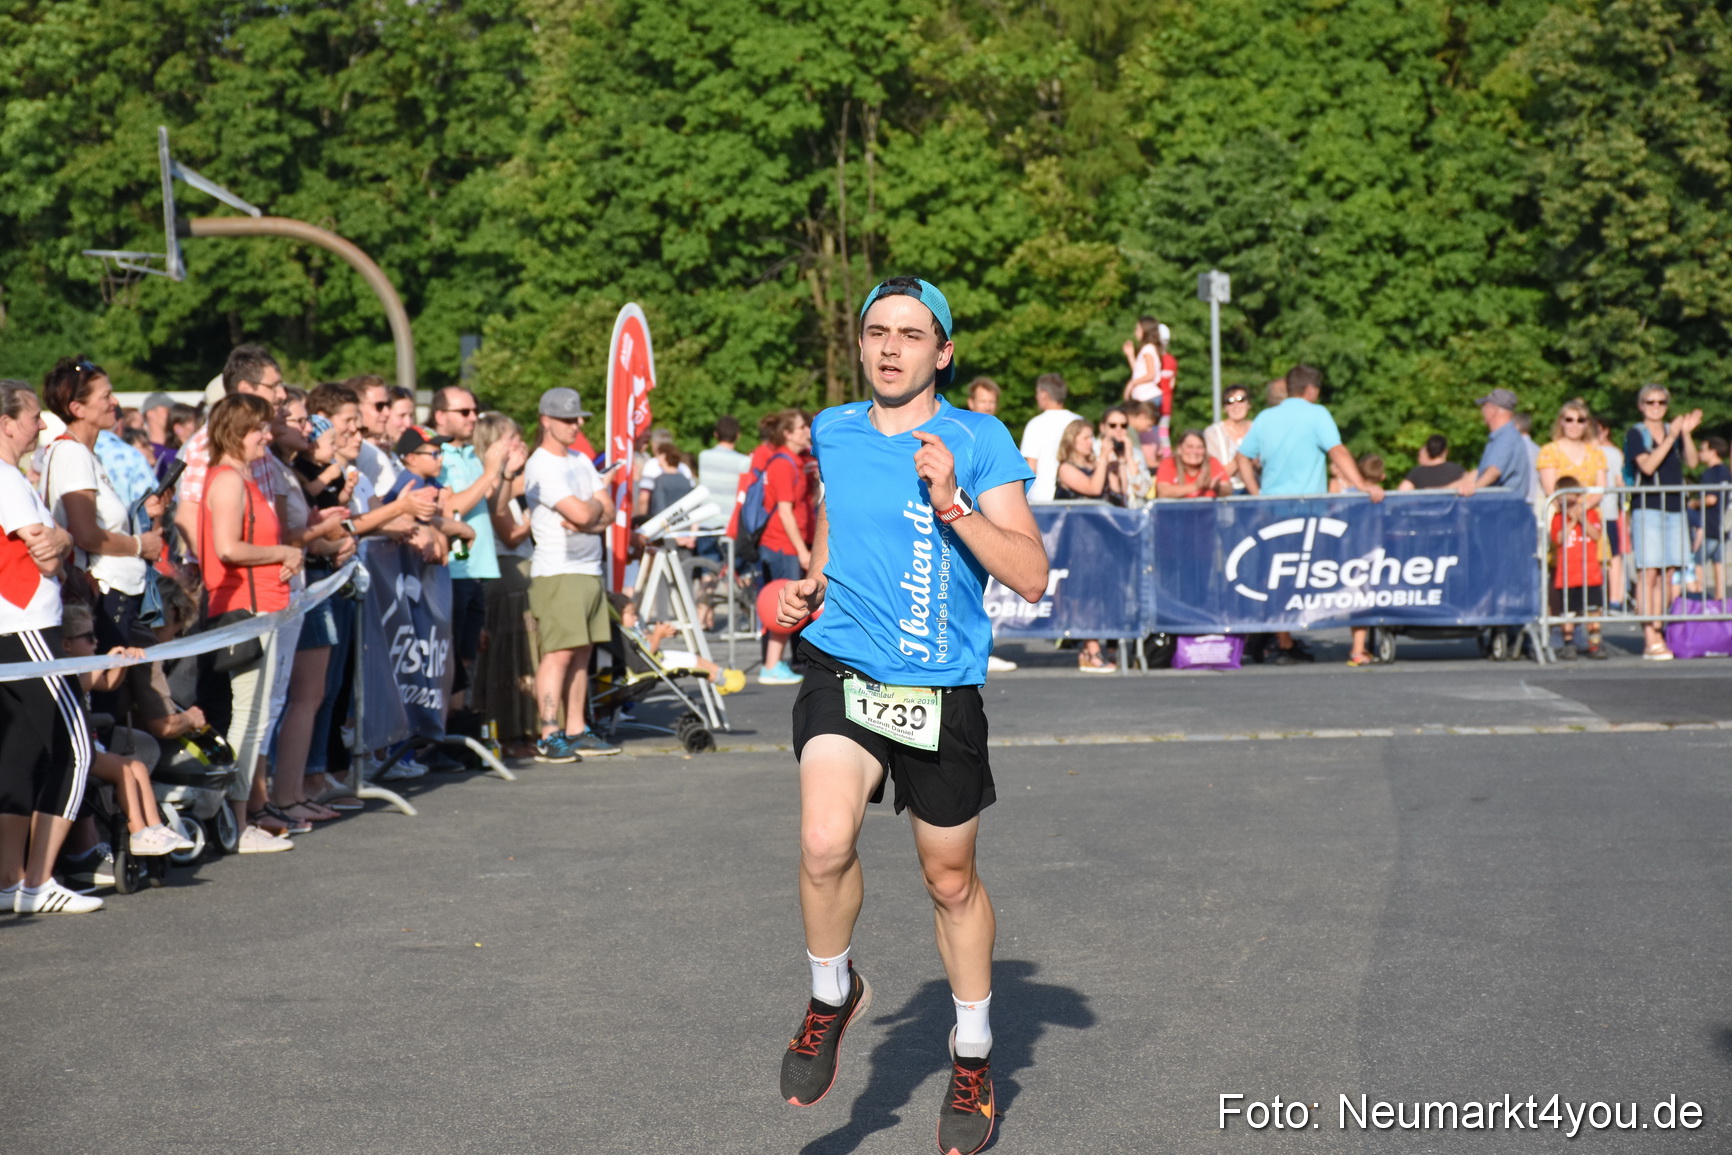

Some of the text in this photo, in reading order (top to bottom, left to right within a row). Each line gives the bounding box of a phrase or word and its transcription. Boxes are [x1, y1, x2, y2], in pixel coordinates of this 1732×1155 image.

[900, 538, 933, 637] bedien
[1267, 548, 1459, 590] Fischer
[935, 522, 951, 664] Nathalies Bedienservi
[984, 601, 1053, 618] OBILE
[1285, 589, 1443, 611] AUTOMOBILE
[389, 624, 450, 678] Fische
[857, 698, 927, 730] 1739
[891, 725, 914, 736] Daniel
